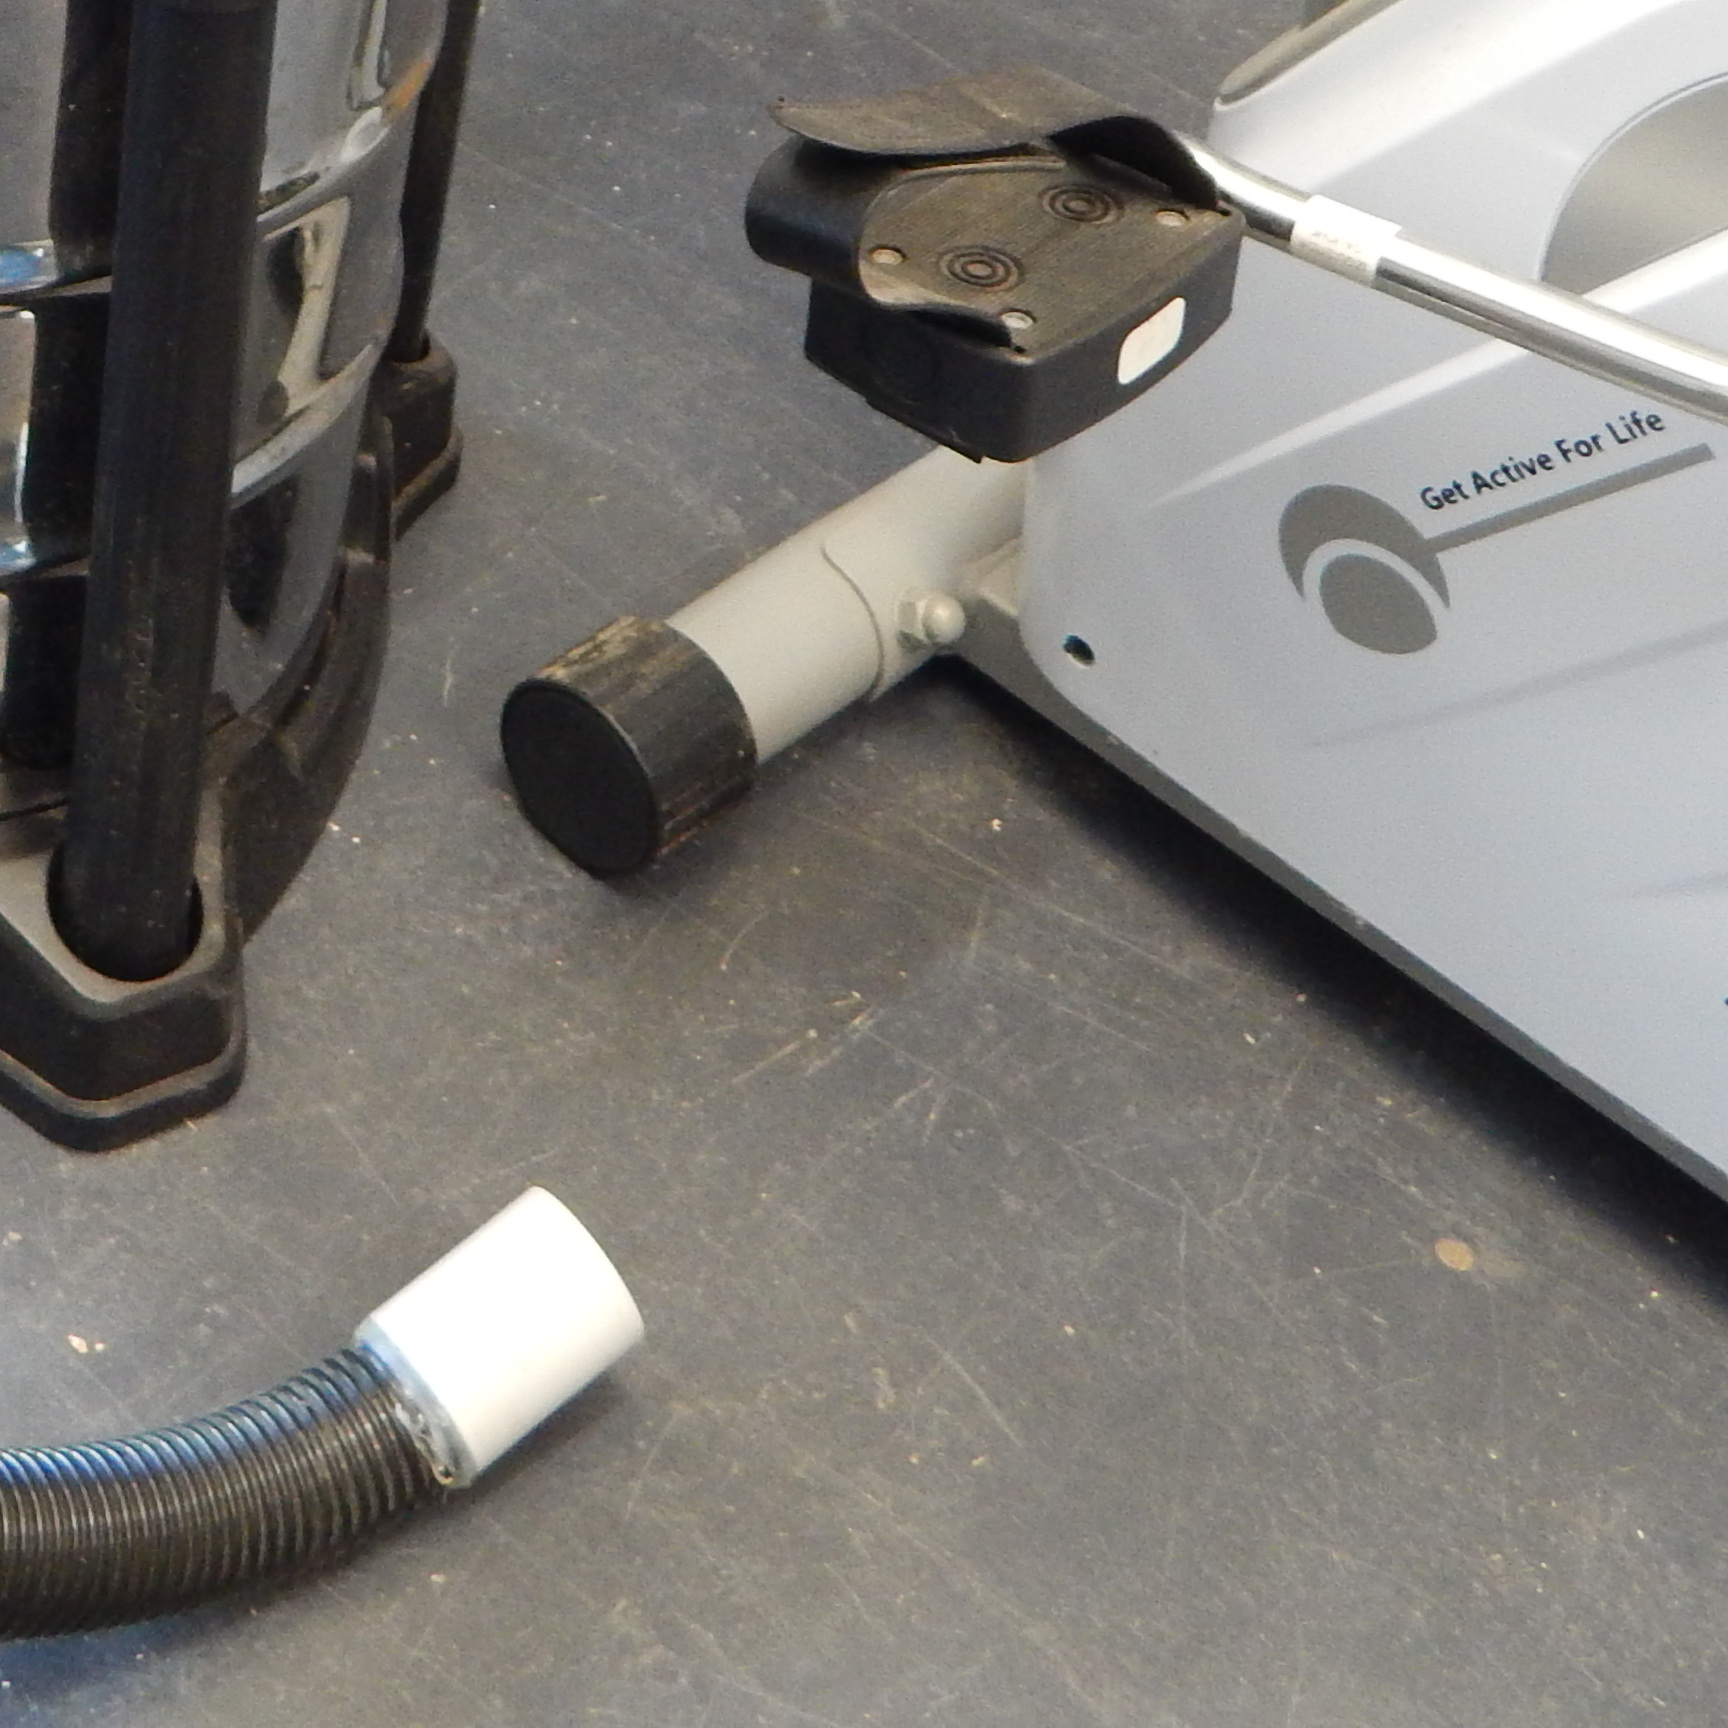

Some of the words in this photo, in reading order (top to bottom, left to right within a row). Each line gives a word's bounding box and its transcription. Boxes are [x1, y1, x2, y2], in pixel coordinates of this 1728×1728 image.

[1420, 481, 1470, 512] Get
[1471, 449, 1554, 496] Active
[1554, 434, 1606, 465] For
[1606, 409, 1667, 446] Life
